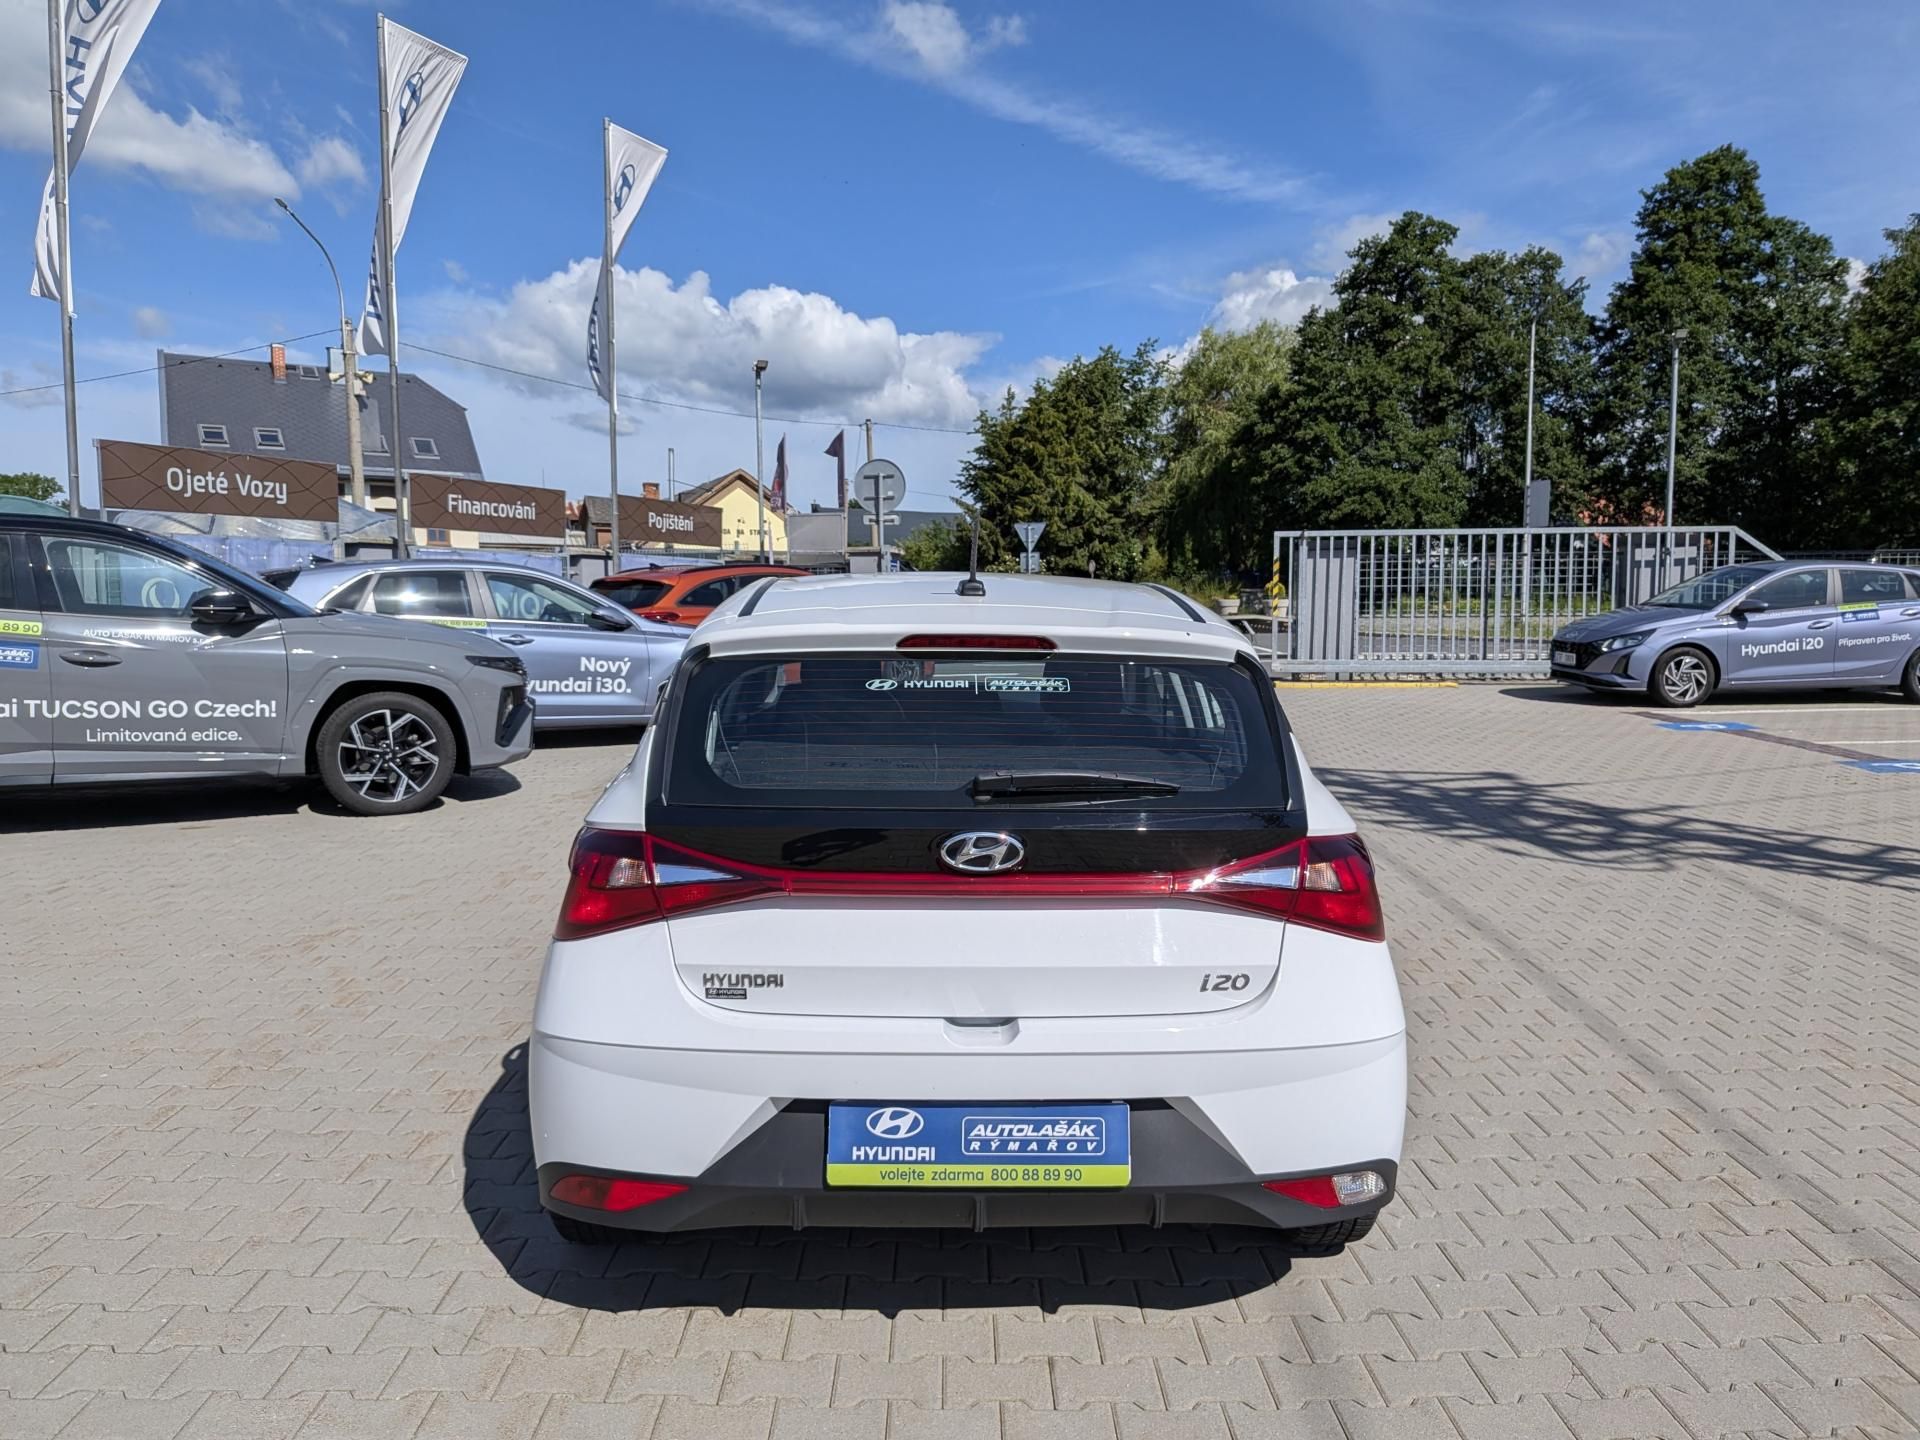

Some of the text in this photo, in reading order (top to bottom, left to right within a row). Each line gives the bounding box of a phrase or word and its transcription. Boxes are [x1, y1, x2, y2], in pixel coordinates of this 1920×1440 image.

[166, 467, 288, 504] Ojeté Vozy
[447, 493, 536, 521] Financování
[2, 622, 40, 634] 89 90
[1741, 637, 1824, 658] Hyundai i20
[1838, 632, 1912, 647] Připraven pro život.
[579, 656, 631, 676] Nový
[596, 676, 632, 693] i30.
[904, 680, 969, 689] HYUNDAI
[23, 699, 141, 719] TUCSON
[148, 700, 188, 718] GO
[194, 700, 277, 718] Czech!
[86, 728, 243, 742] Limitovaná edice.
[703, 973, 784, 988] HYUNDAI
[1199, 973, 1250, 992] i20
[969, 1120, 1096, 1137] AUTOLAŠÁK
[852, 1146, 936, 1161] HYUNDAI
[880, 1168, 1083, 1183] volejte zdarma 800 88 89 90
